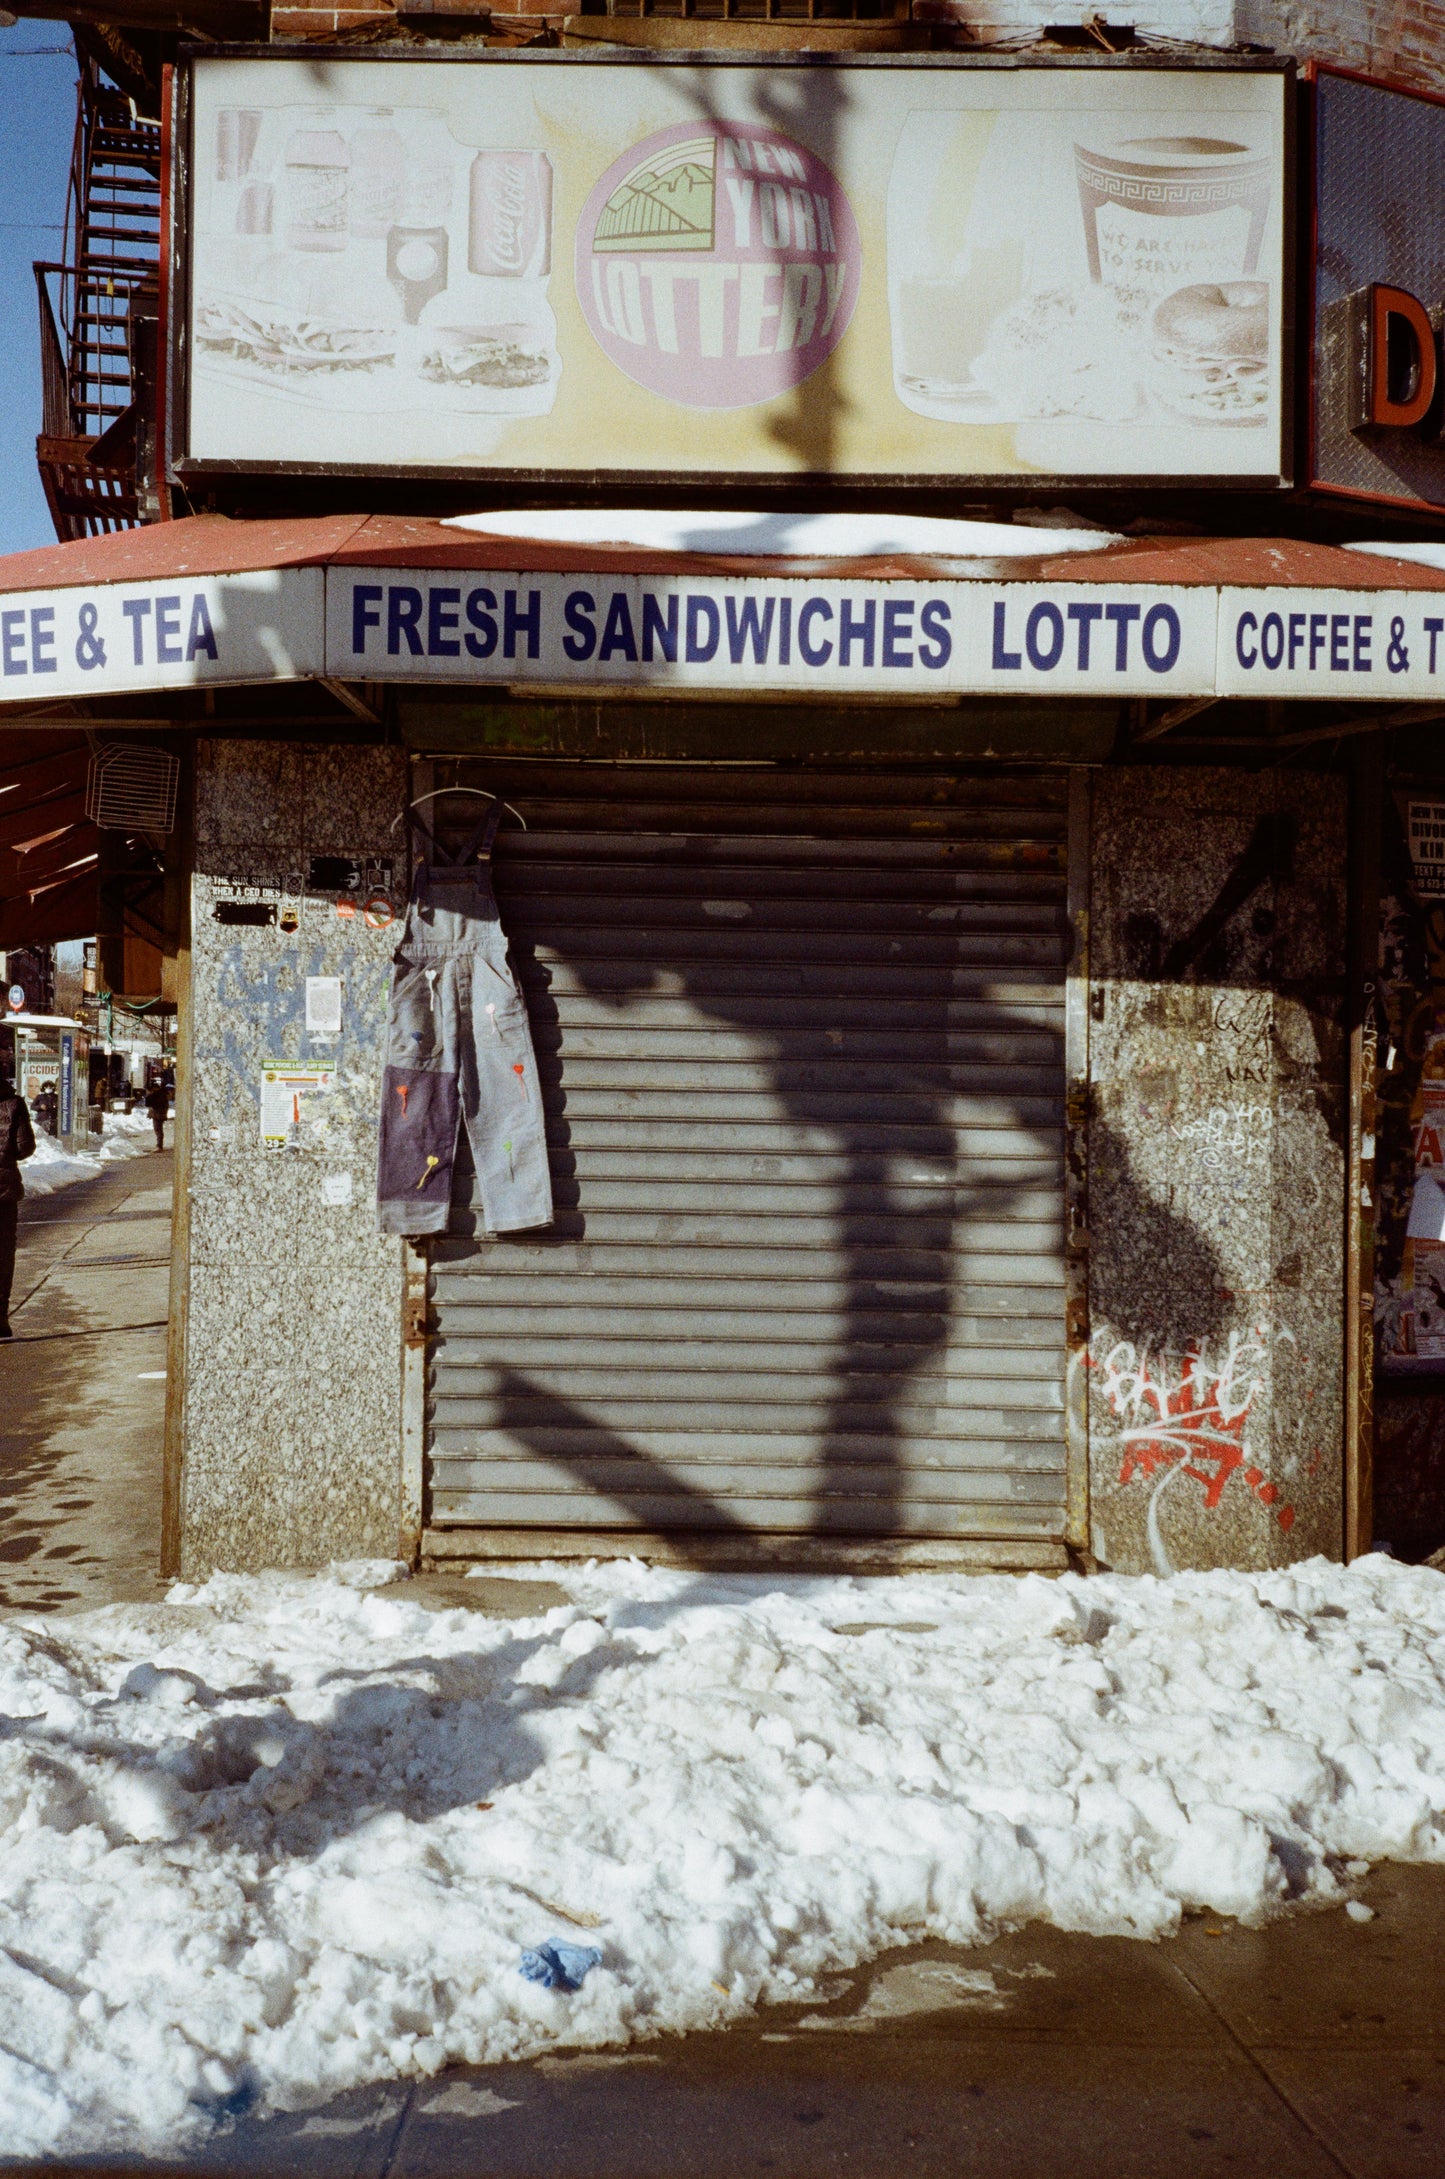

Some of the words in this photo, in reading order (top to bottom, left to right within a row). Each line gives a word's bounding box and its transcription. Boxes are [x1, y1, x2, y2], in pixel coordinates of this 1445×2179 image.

[724, 136, 807, 182] NEW
[724, 178, 837, 253] YORK
[1101, 249, 1124, 267] TO
[1135, 238, 1172, 252] ARE
[591, 259, 846, 358] LOTTERY
[1373, 282, 1436, 427] D
[75, 602, 107, 671] &
[122, 594, 219, 666] TEA
[352, 585, 541, 659] FRESH
[562, 590, 952, 670] SANDWICHES
[992, 601, 1181, 674] LOTTO
[1236, 611, 1372, 672] COFFEE
[1386, 615, 1410, 674] &
[1423, 617, 1444, 674] T
[213, 876, 230, 886] THE
[232, 876, 249, 886] SUN
[251, 876, 281, 887] SHINES
[213, 886, 233, 897] WHEN
[236, 887, 242, 897] A
[244, 888, 261, 898] CEO
[263, 888, 280, 899] DIES
[1414, 865, 1433, 877] TEXT
